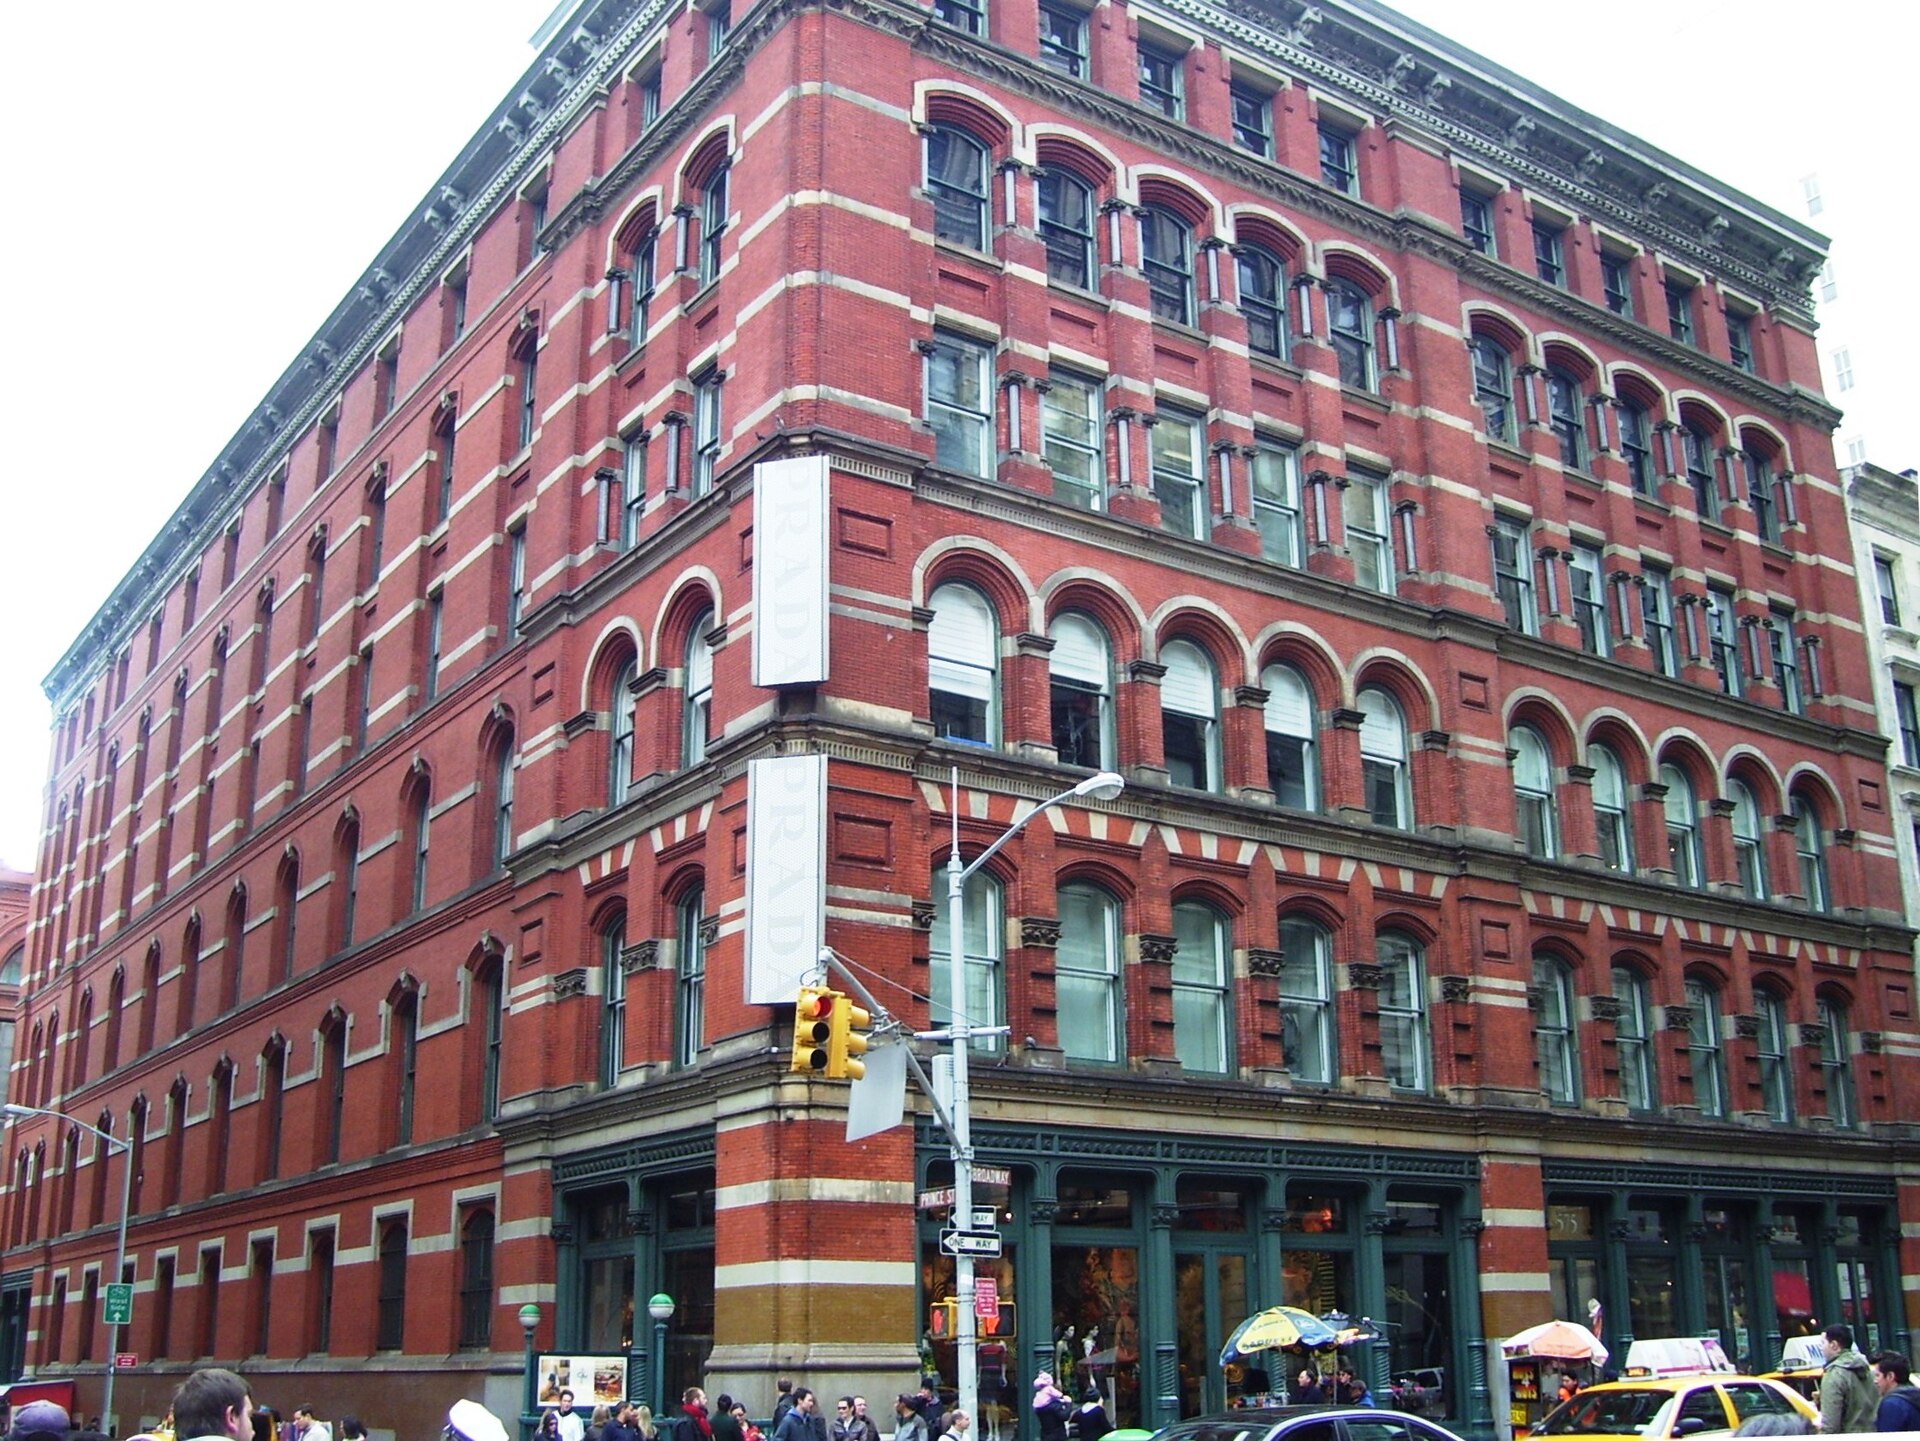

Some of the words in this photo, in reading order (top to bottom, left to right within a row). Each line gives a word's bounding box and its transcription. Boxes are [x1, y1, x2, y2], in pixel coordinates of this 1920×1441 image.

[774, 458, 810, 682] PRADA
[765, 757, 807, 1001] PRADA
[972, 1167, 1010, 1185] BROADWAY
[920, 1190, 944, 1207] PRINCE
[974, 1214, 989, 1222] WAY
[1556, 1213, 1578, 1234] 575
[948, 1237, 965, 1248] ONE
[975, 1240, 992, 1249] WAY
